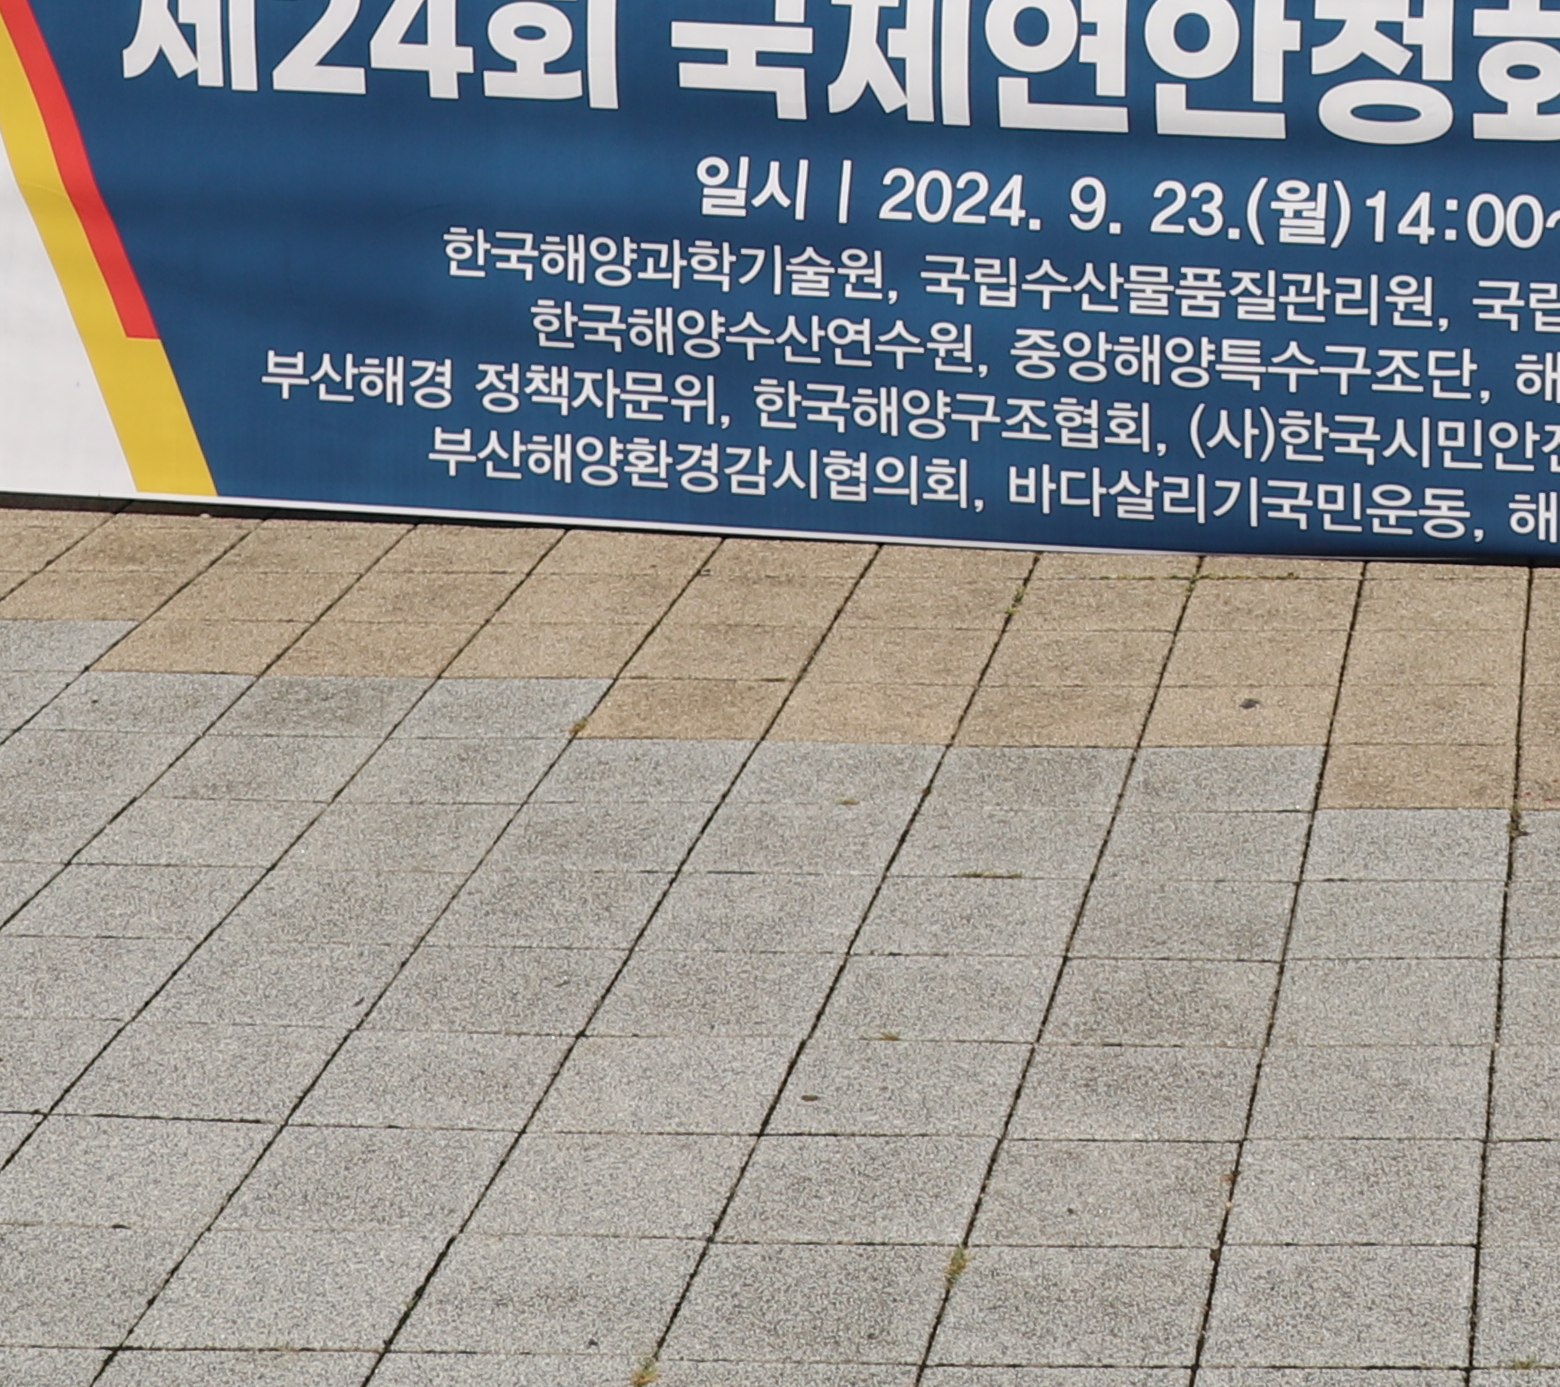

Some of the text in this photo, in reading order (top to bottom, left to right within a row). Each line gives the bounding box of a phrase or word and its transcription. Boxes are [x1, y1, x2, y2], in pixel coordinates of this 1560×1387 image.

[696, 156, 808, 220] 일시
[879, 167, 1041, 231] 2024.
[1070, 177, 1122, 234] 9.
[443, 227, 898, 304] 한국해양과학기술원,
[920, 253, 1449, 331] 국립수산물품질관리원,
[261, 349, 454, 410] 부산해경
[475, 362, 730, 429] 정책자문위,
[753, 377, 1167, 456] 한국해양구조협회,
[530, 299, 988, 377] 한국해양수산연수원,
[1010, 327, 1491, 404] 중앙해양특수구조단,
[428, 426, 984, 512] 부산해양환경감시협의회,
[1007, 463, 1484, 542] 바다살리기국민운동,
